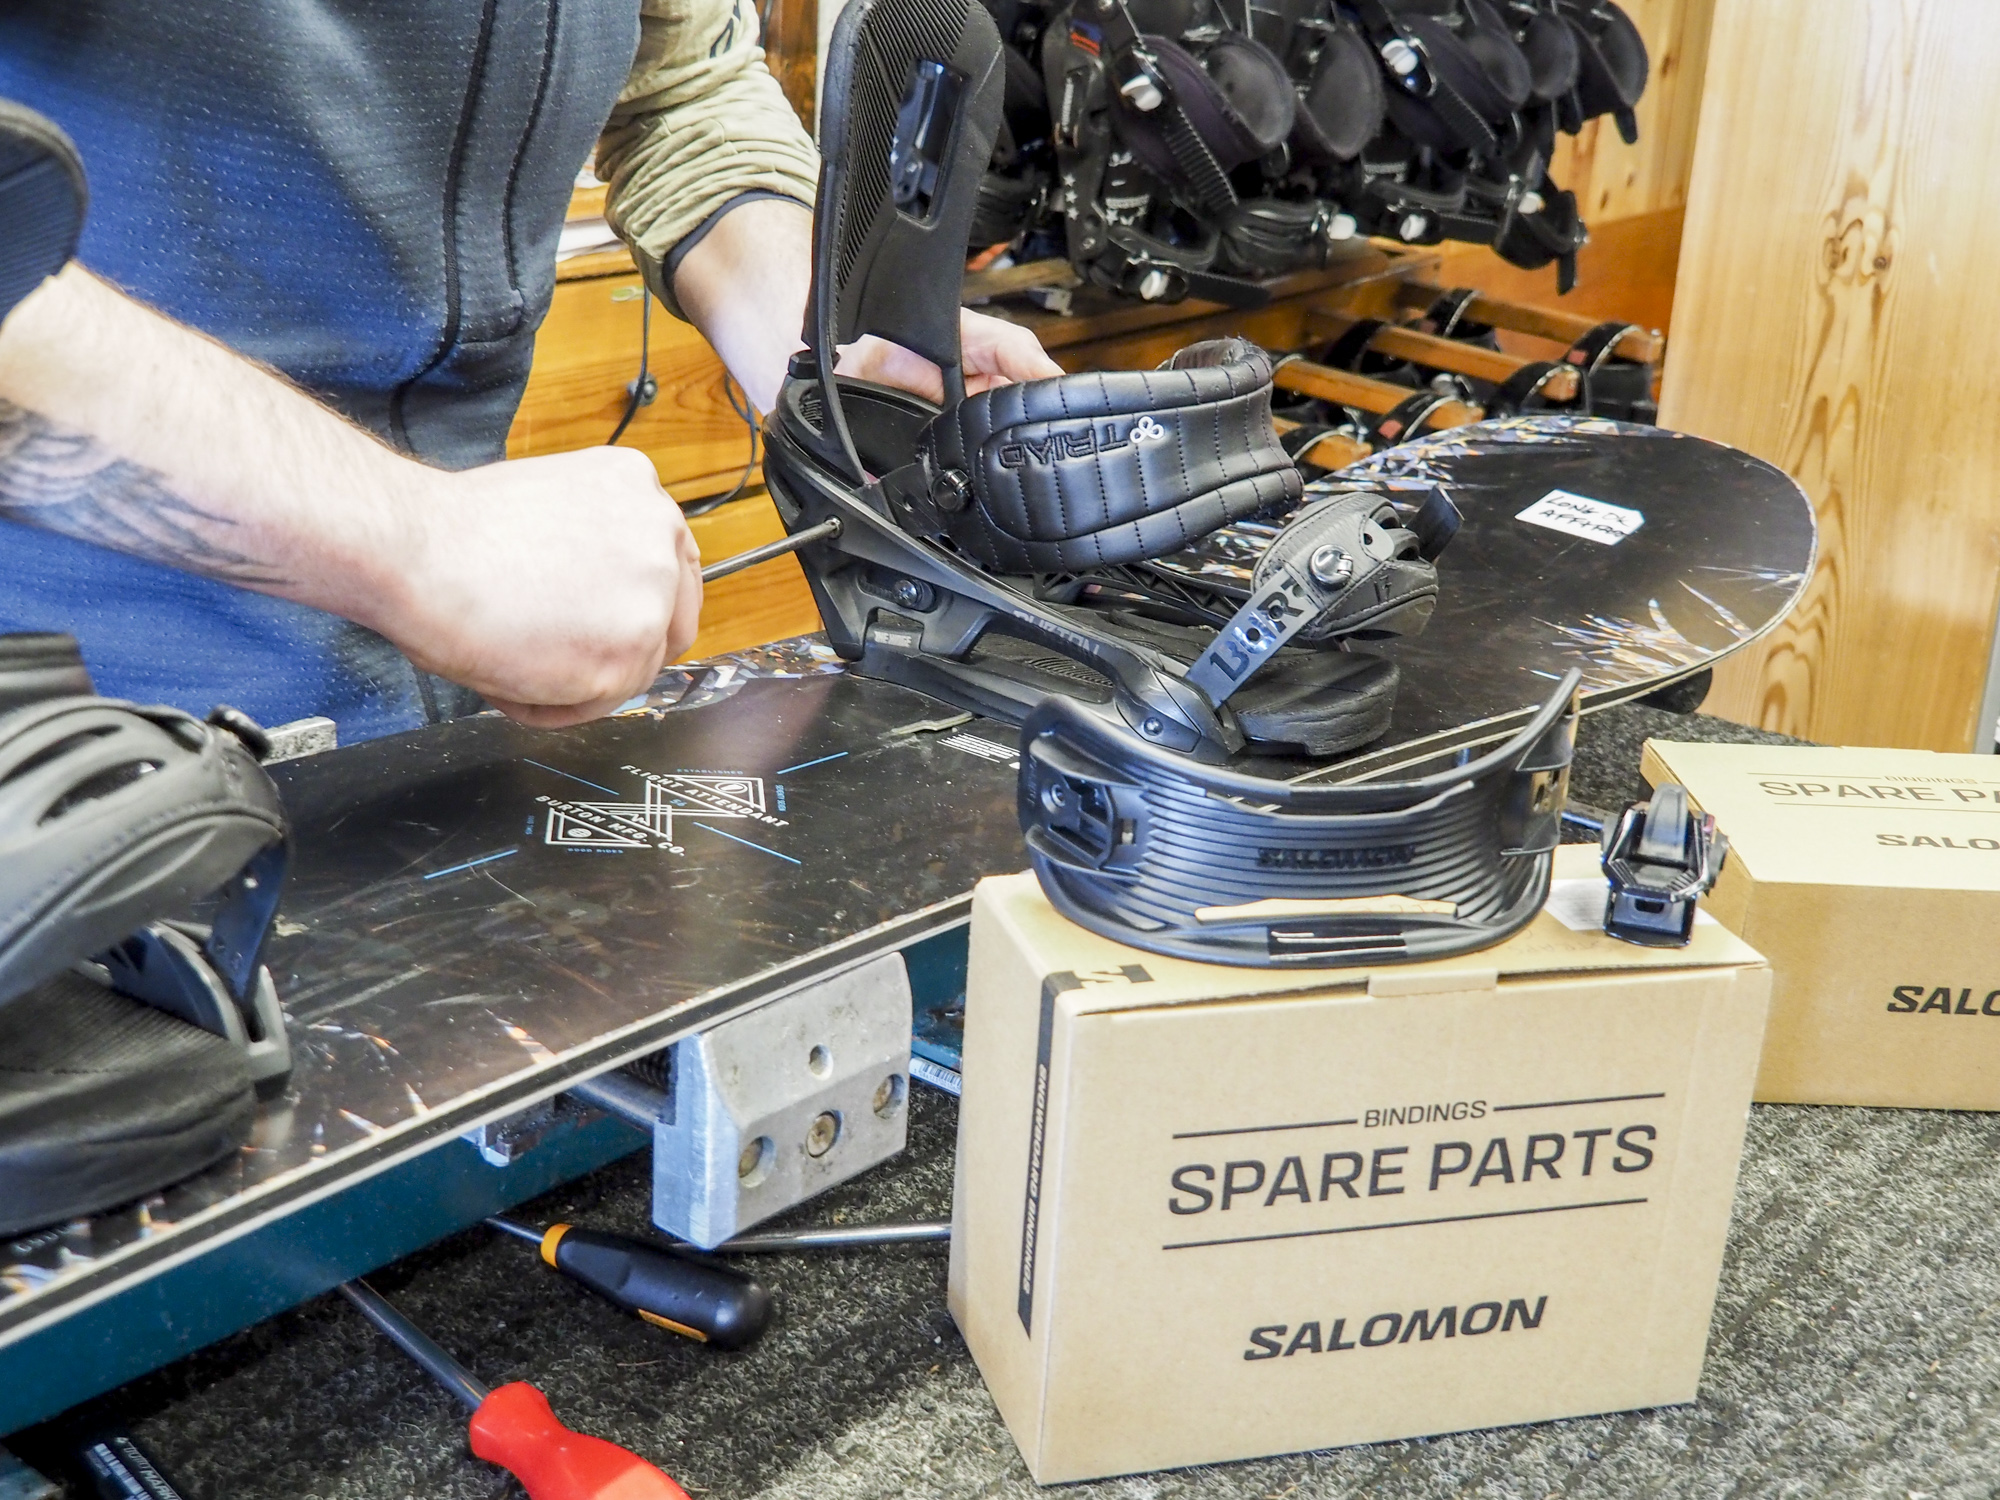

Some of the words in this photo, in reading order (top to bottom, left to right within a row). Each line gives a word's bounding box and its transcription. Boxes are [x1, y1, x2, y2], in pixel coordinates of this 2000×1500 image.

[999, 422, 1129, 469] TRIAD
[620, 764, 684, 789] FLIGHT
[684, 789, 790, 827] ATTENDANT
[1758, 781, 1944, 801] SPARE
[1951, 787, 2000, 804] P
[1883, 775, 1978, 785] BINDINGS
[535, 795, 606, 824] BURTON
[608, 821, 649, 842] MFG.
[657, 841, 685, 857] CO.
[1029, 1063, 1048, 1198] SNOWBOARD
[1363, 1100, 1487, 1128] BINDINGS
[1168, 1146, 1409, 1215] SPARE
[1428, 1124, 1657, 1191] PARTS
[1022, 1198, 1036, 1295] BINDINGS
[1243, 1295, 1549, 1361] SALOMON
